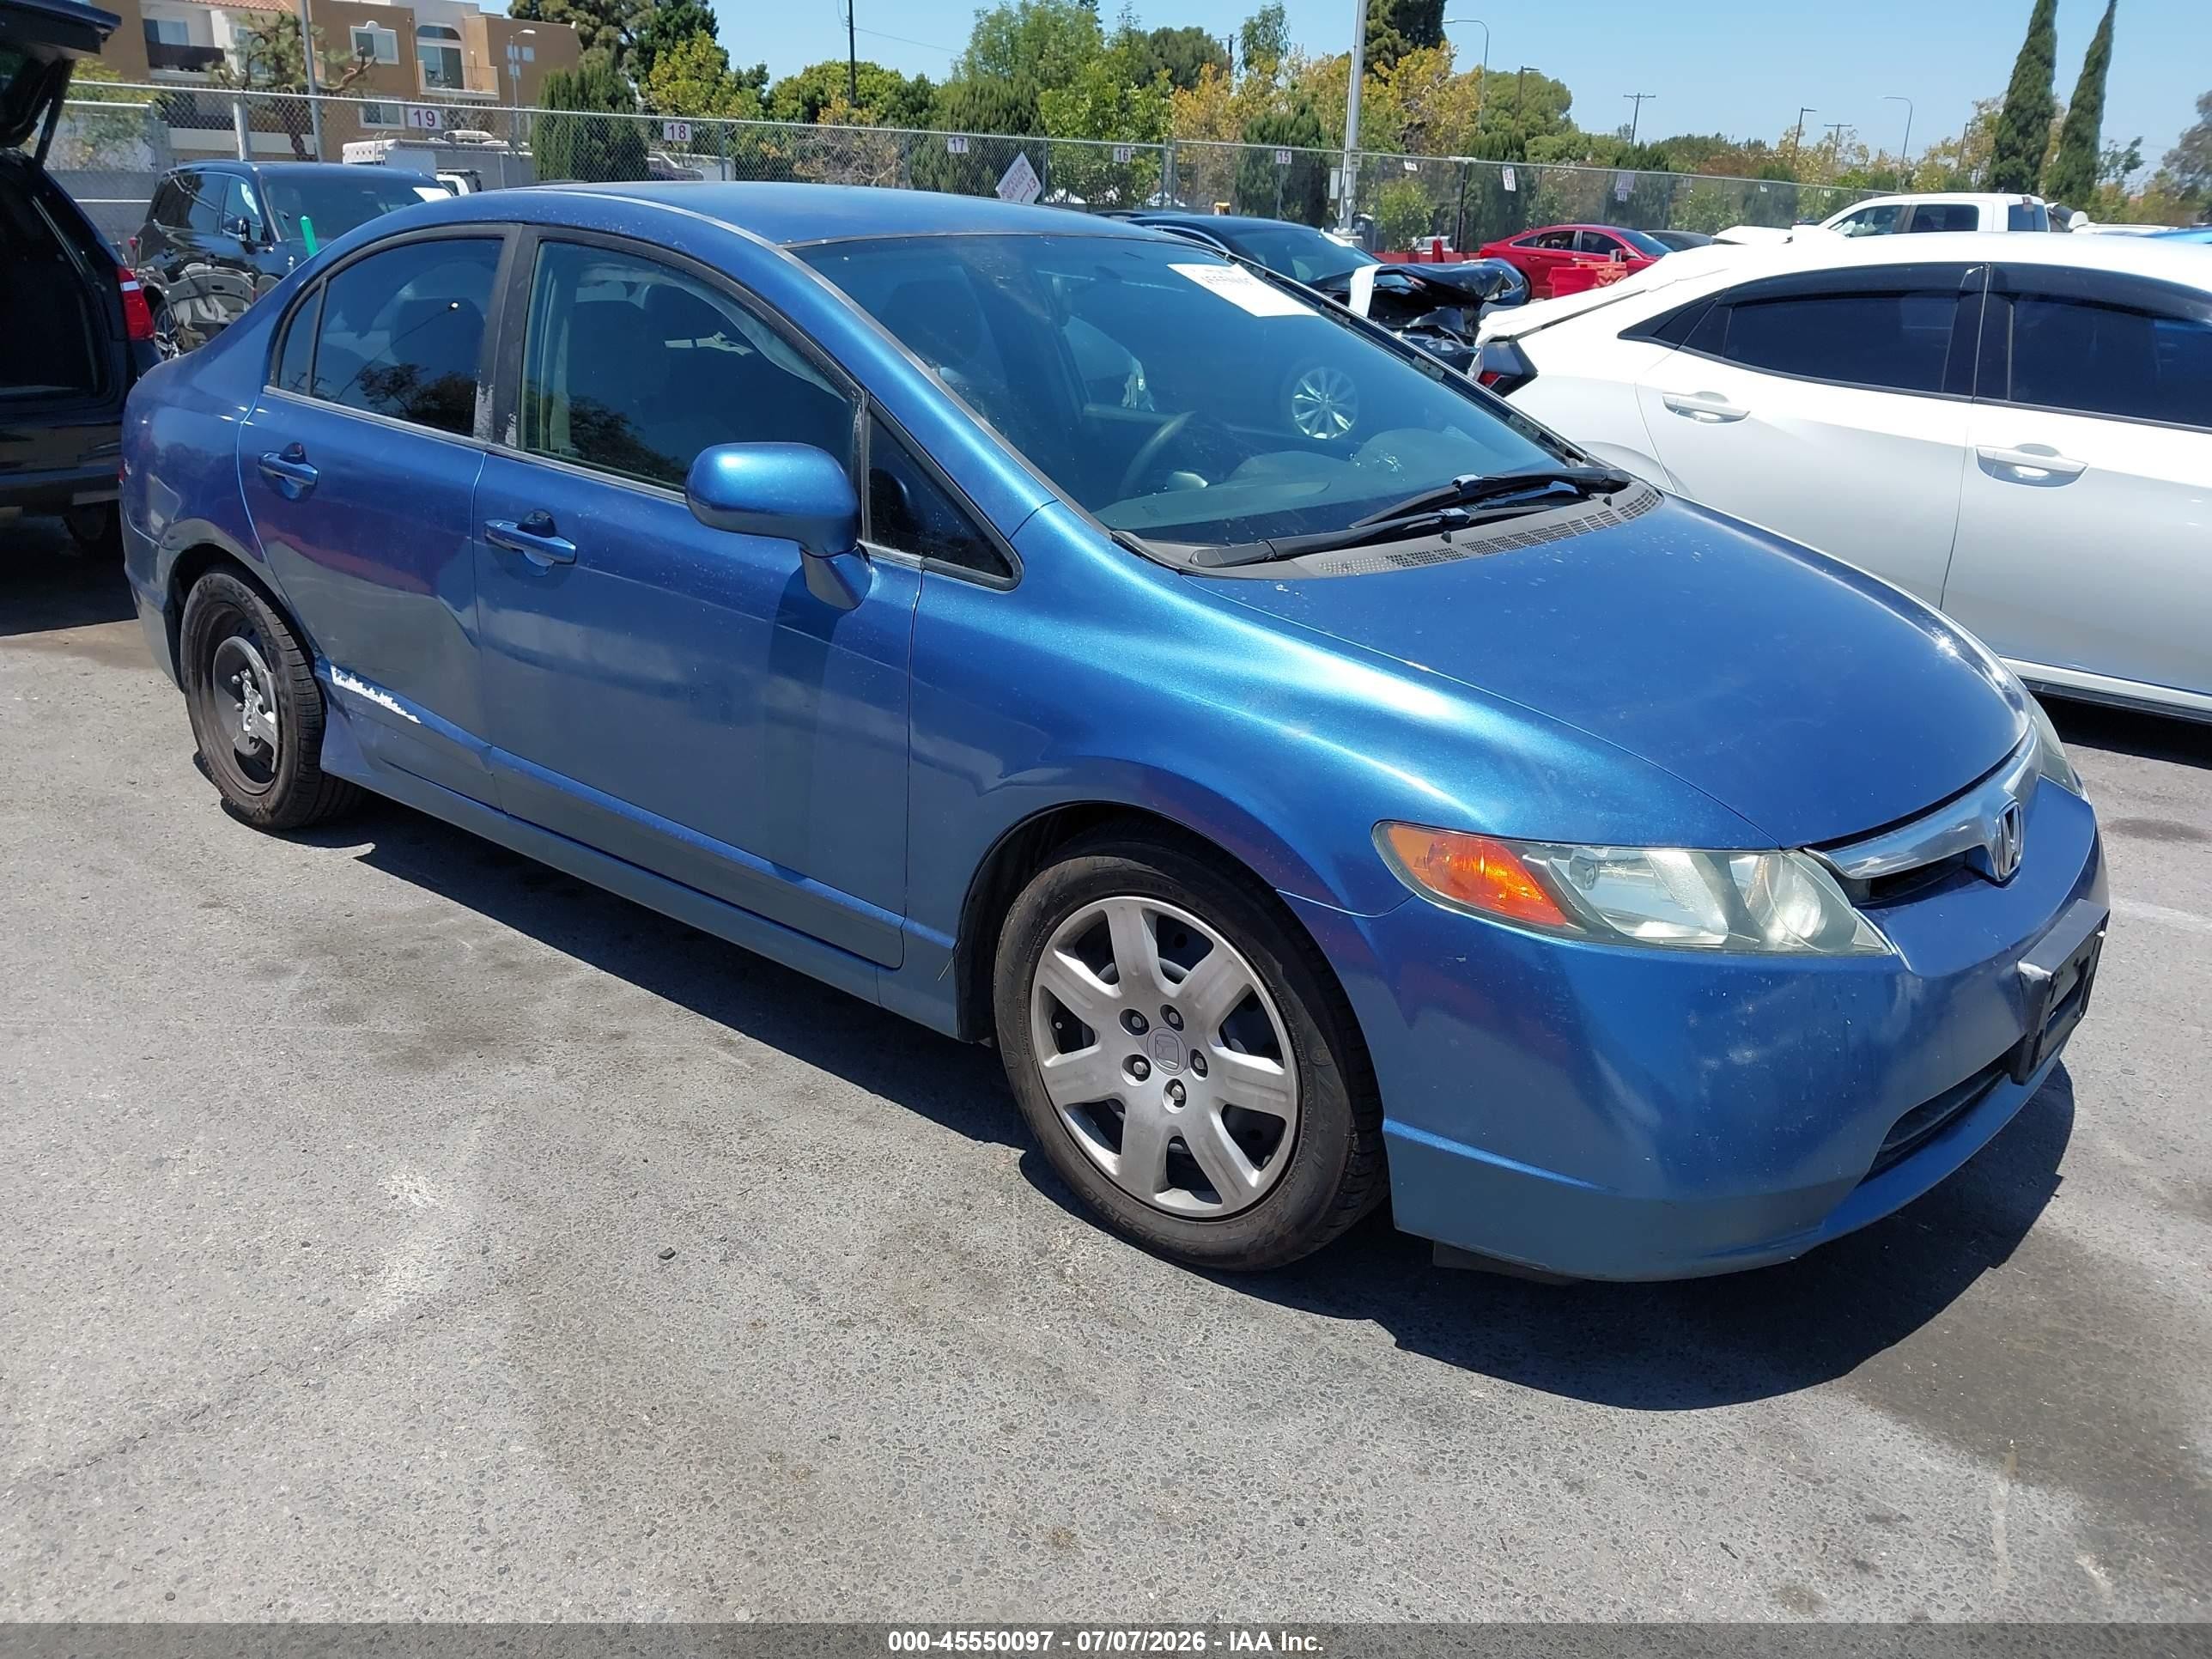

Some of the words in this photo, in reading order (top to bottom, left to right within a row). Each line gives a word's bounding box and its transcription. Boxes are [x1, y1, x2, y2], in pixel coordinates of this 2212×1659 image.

[413, 109, 435, 127] 19
[669, 124, 687, 140] 18
[951, 138, 965, 152] 17
[1117, 148, 1129, 161] 16
[1279, 152, 1290, 163] 15
